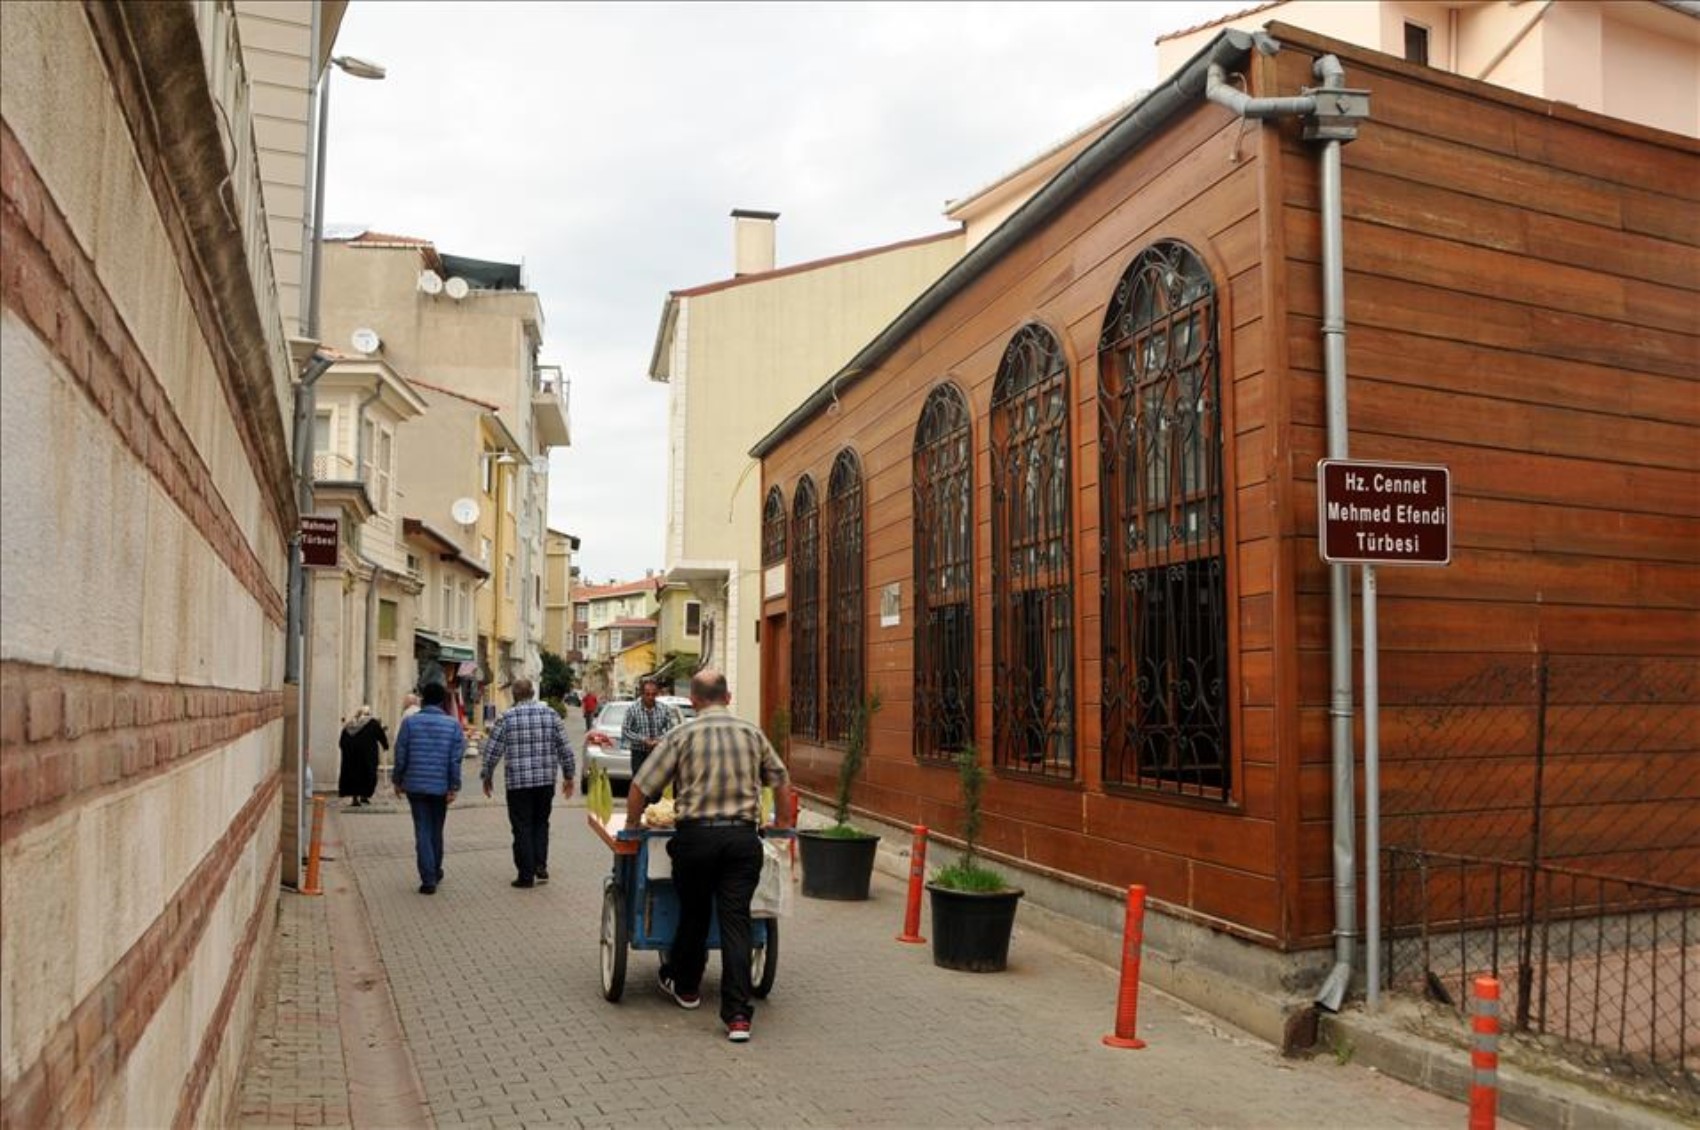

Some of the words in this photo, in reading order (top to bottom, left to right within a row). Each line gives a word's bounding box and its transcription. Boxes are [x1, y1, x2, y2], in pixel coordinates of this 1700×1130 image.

[1345, 472, 1369, 491] Hz.
[1374, 473, 1427, 494] Cennet
[1328, 502, 1391, 522] Mehmed
[1397, 505, 1445, 525] Efendi
[301, 534, 336, 546] Türbesi
[1356, 533, 1420, 553] Türbesi
